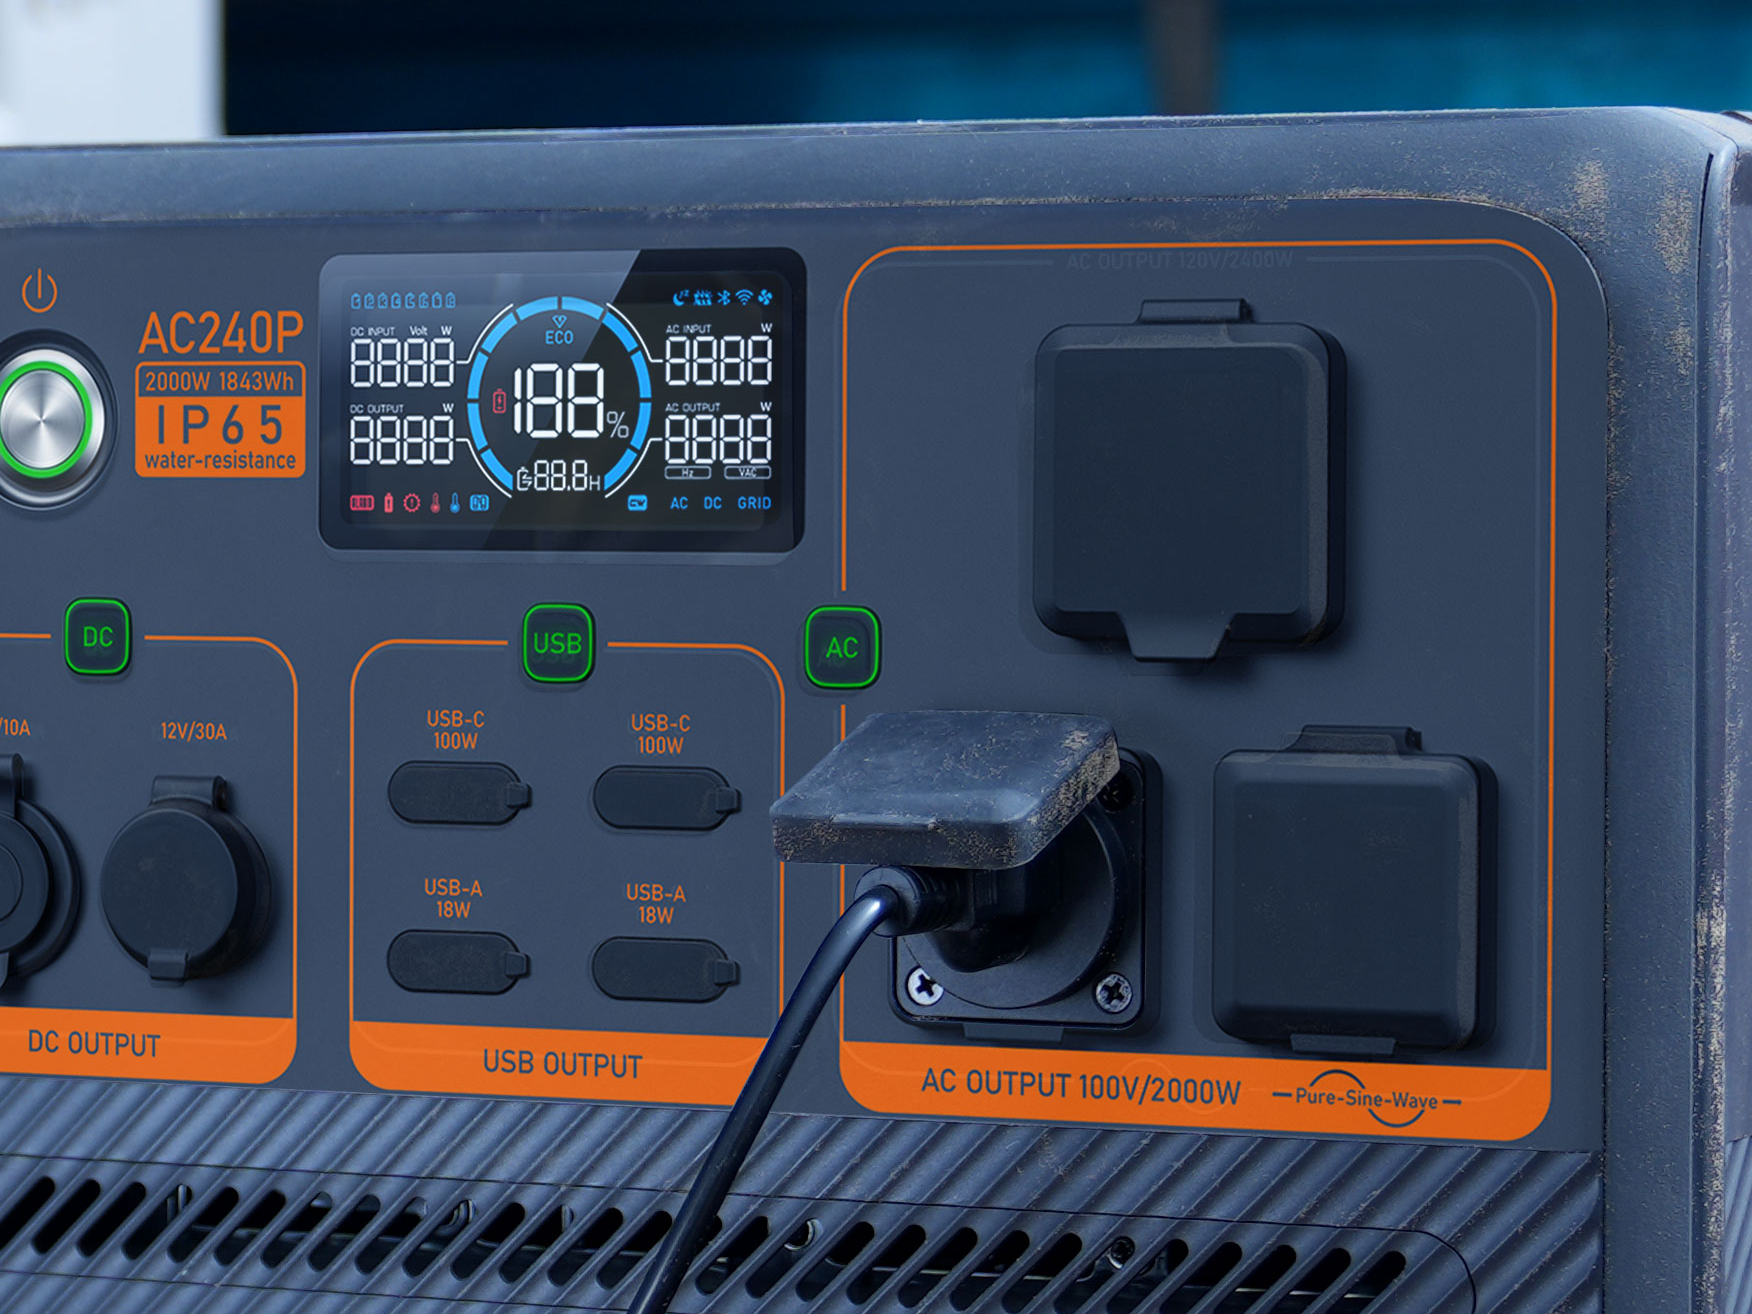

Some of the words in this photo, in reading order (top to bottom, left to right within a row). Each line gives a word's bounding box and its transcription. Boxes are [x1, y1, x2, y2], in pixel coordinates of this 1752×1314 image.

[1098, 251, 1173, 270] OUTPUT
[138, 310, 304, 354] AC240P
[350, 327, 365, 336] DC
[368, 326, 396, 336] INPUT
[409, 325, 428, 336] Volt
[441, 326, 453, 335] W
[545, 330, 574, 345] ECO
[666, 324, 680, 334] AC
[683, 324, 712, 334] INPUT
[760, 323, 773, 333] W
[350, 338, 455, 388] 8888
[665, 335, 773, 386] 8888
[145, 371, 211, 391] 2000W
[219, 371, 294, 391] 1843Wh
[349, 404, 364, 414] DC
[367, 403, 404, 413] OUTPUT
[442, 403, 454, 413] W
[665, 402, 680, 412] AC
[682, 402, 721, 412] OUTPUT
[760, 402, 772, 412] W
[349, 415, 455, 465] 8888
[664, 414, 772, 464] 8888
[144, 449, 297, 469] water-resistance
[739, 468, 757, 478] VAC
[670, 496, 688, 509] AC
[703, 496, 722, 509] DC
[737, 496, 772, 509] GRID
[84, 626, 113, 648] DC
[533, 631, 583, 655] USB
[826, 636, 859, 659] AC
[427, 710, 485, 729] USB-C
[631, 714, 691, 733] USB-C
[160, 721, 228, 742] 12V/30A
[433, 731, 479, 749] 100W
[638, 736, 684, 754] 100W
[424, 878, 483, 897] USB-A
[627, 883, 687, 902] USB-A
[437, 900, 472, 918] 18W
[639, 905, 675, 924] 18W
[28, 1028, 58, 1054] DC
[68, 1031, 161, 1058] OUTPUT
[483, 1048, 534, 1075] USB
[543, 1051, 643, 1079] OUTPUT
[921, 1067, 957, 1093] AC
[966, 1069, 1073, 1098] OUTPUT
[1080, 1074, 1241, 1106] 100V/2000W
[1295, 1086, 1438, 1111] Pure-Sine-Wave
